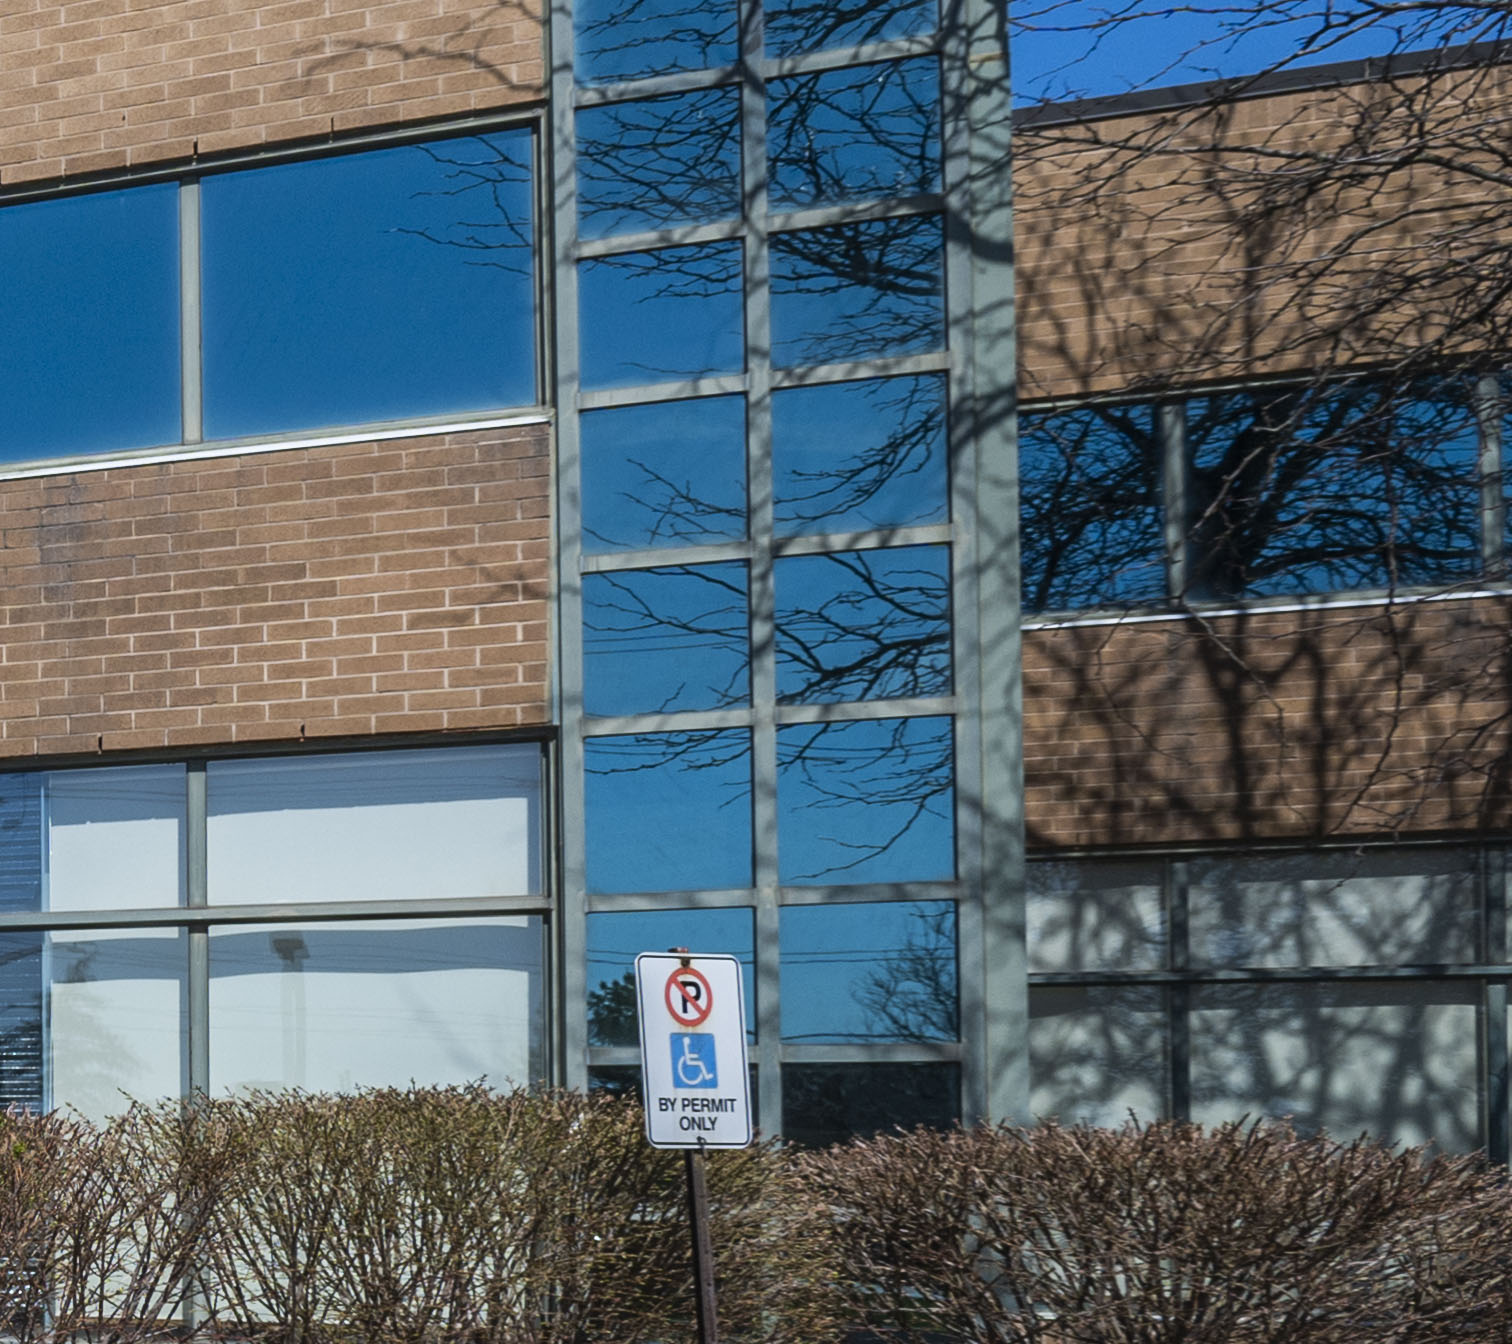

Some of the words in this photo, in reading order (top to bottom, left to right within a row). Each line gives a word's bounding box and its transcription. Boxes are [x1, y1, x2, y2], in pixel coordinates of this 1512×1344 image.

[658, 1097, 677, 1113] BY
[681, 1097, 737, 1113] PERMIT
[679, 1116, 718, 1132] ONLY
